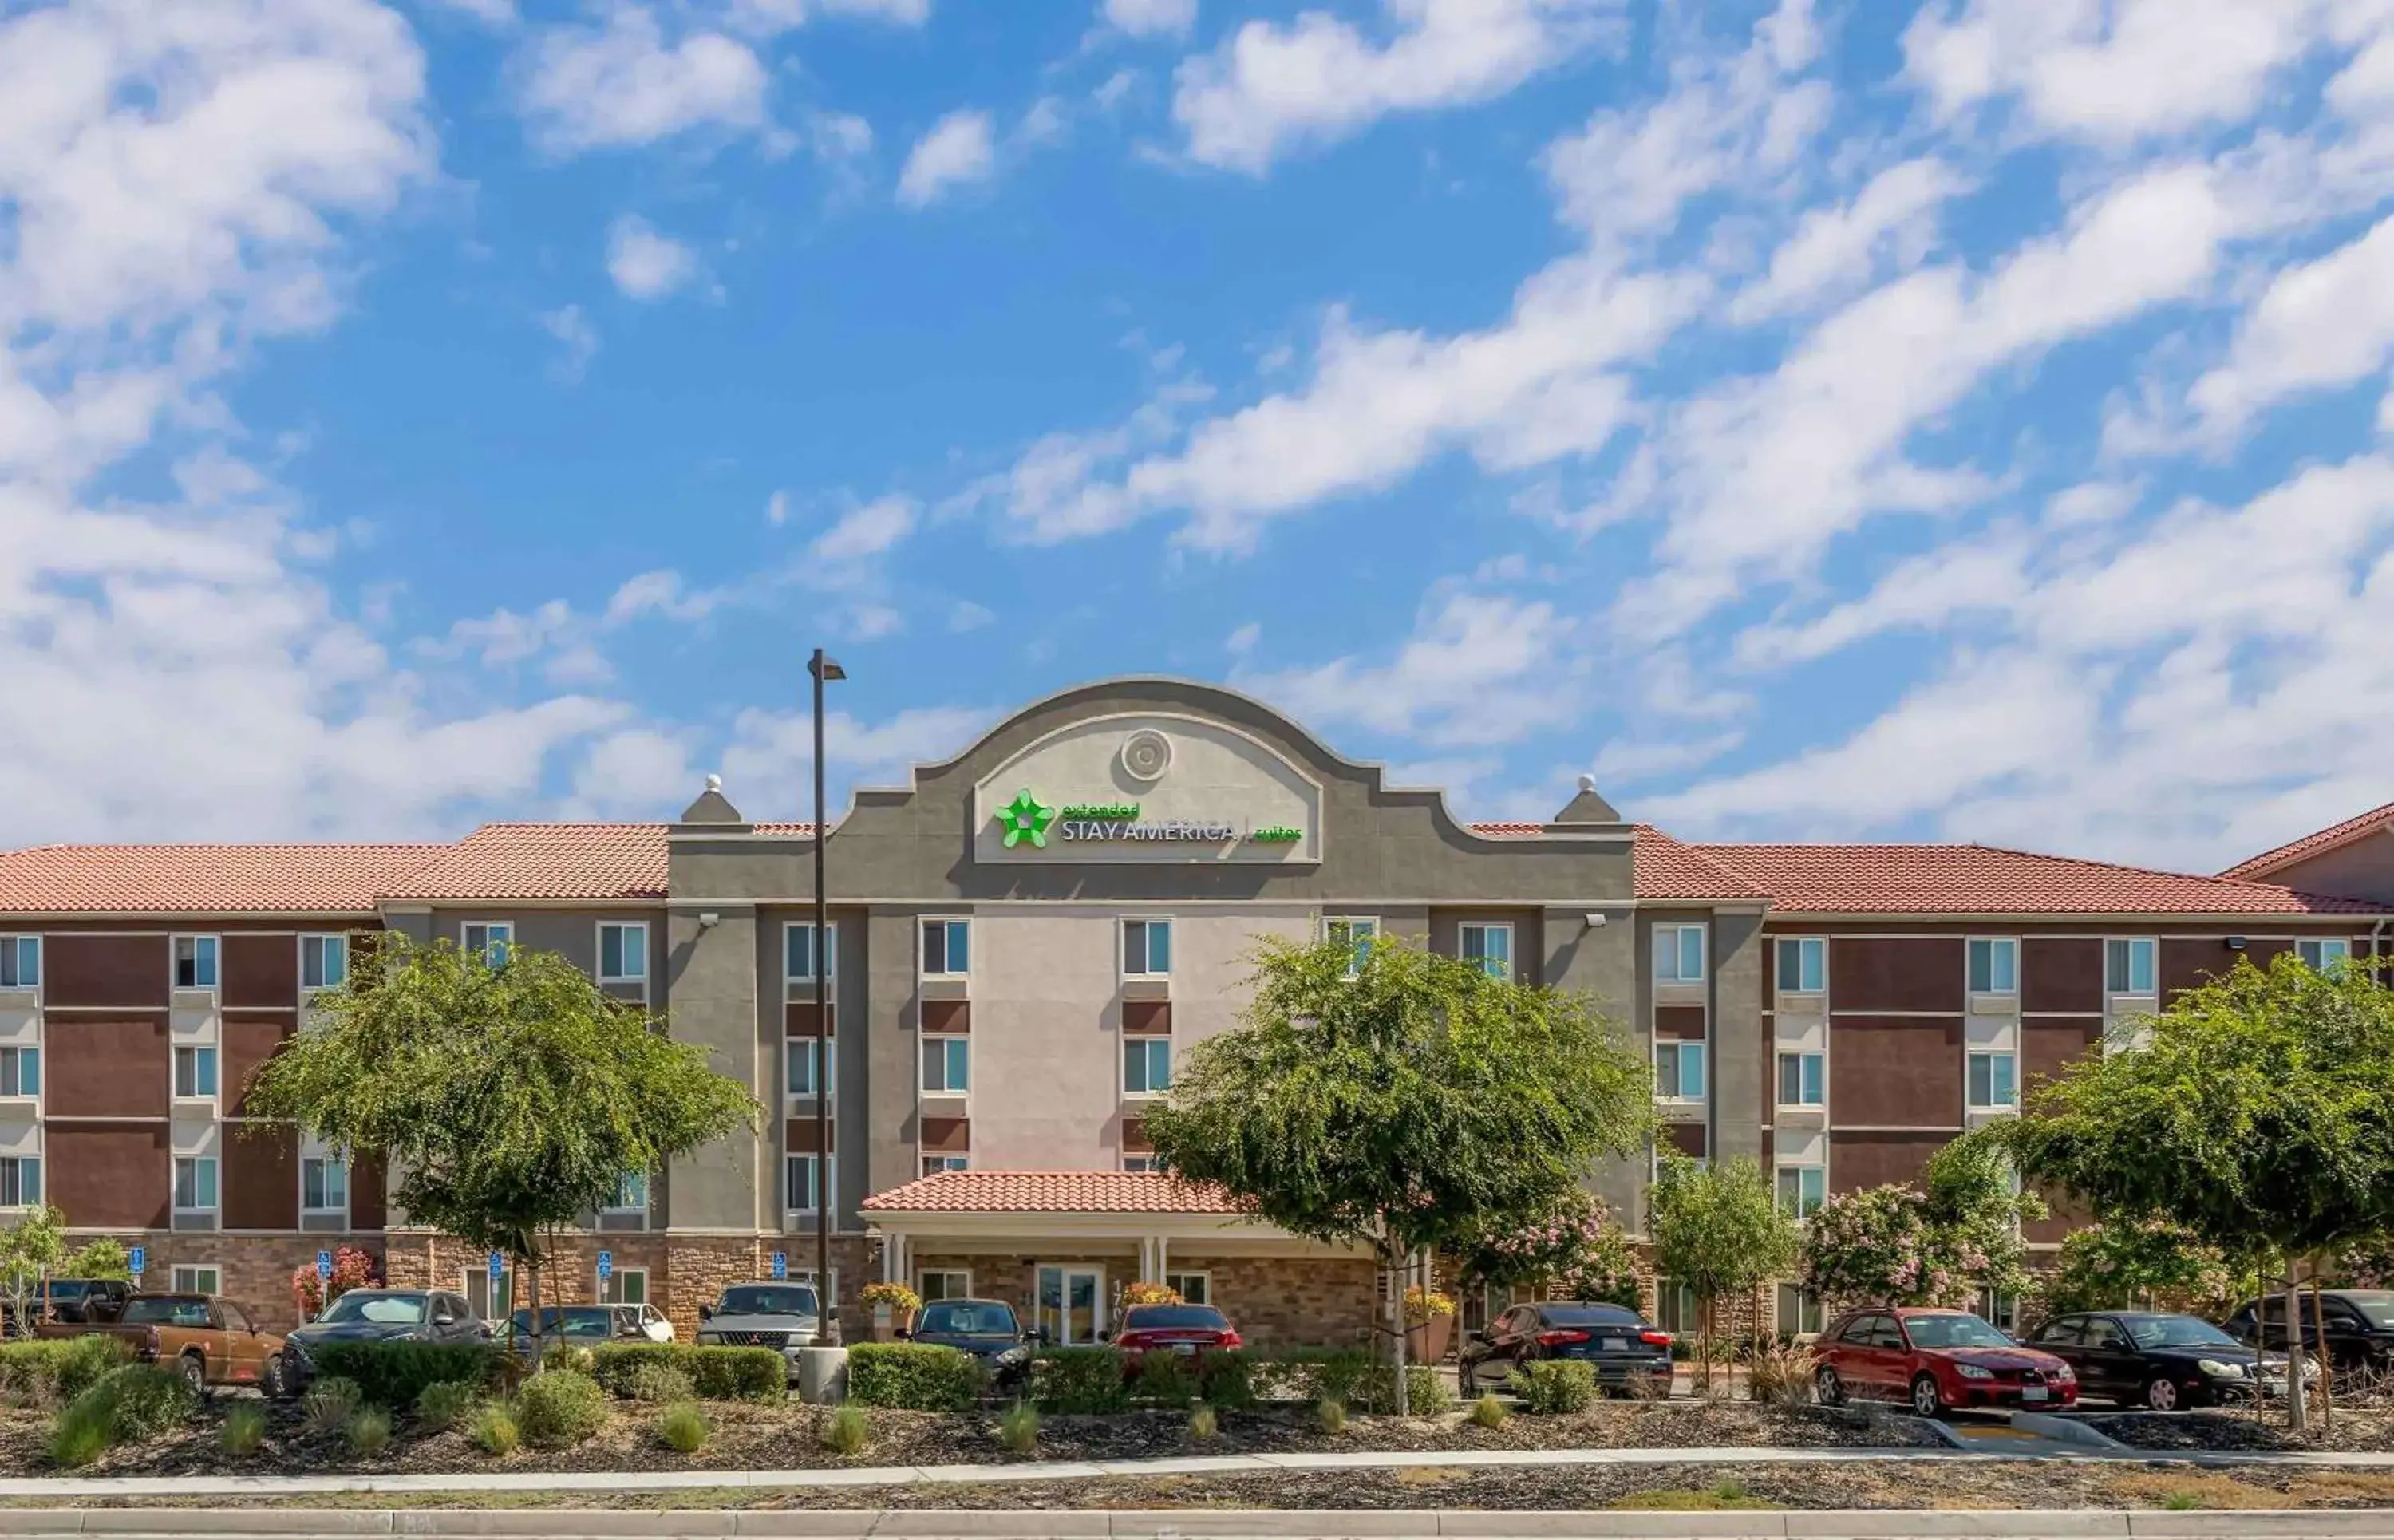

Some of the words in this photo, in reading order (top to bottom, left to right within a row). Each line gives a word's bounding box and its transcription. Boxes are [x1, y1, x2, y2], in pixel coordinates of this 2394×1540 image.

[1062, 802, 1140, 818] extended
[1062, 821, 1118, 840] STAY
[1122, 821, 1238, 841] AMERICA
[1253, 826, 1302, 840] suites
